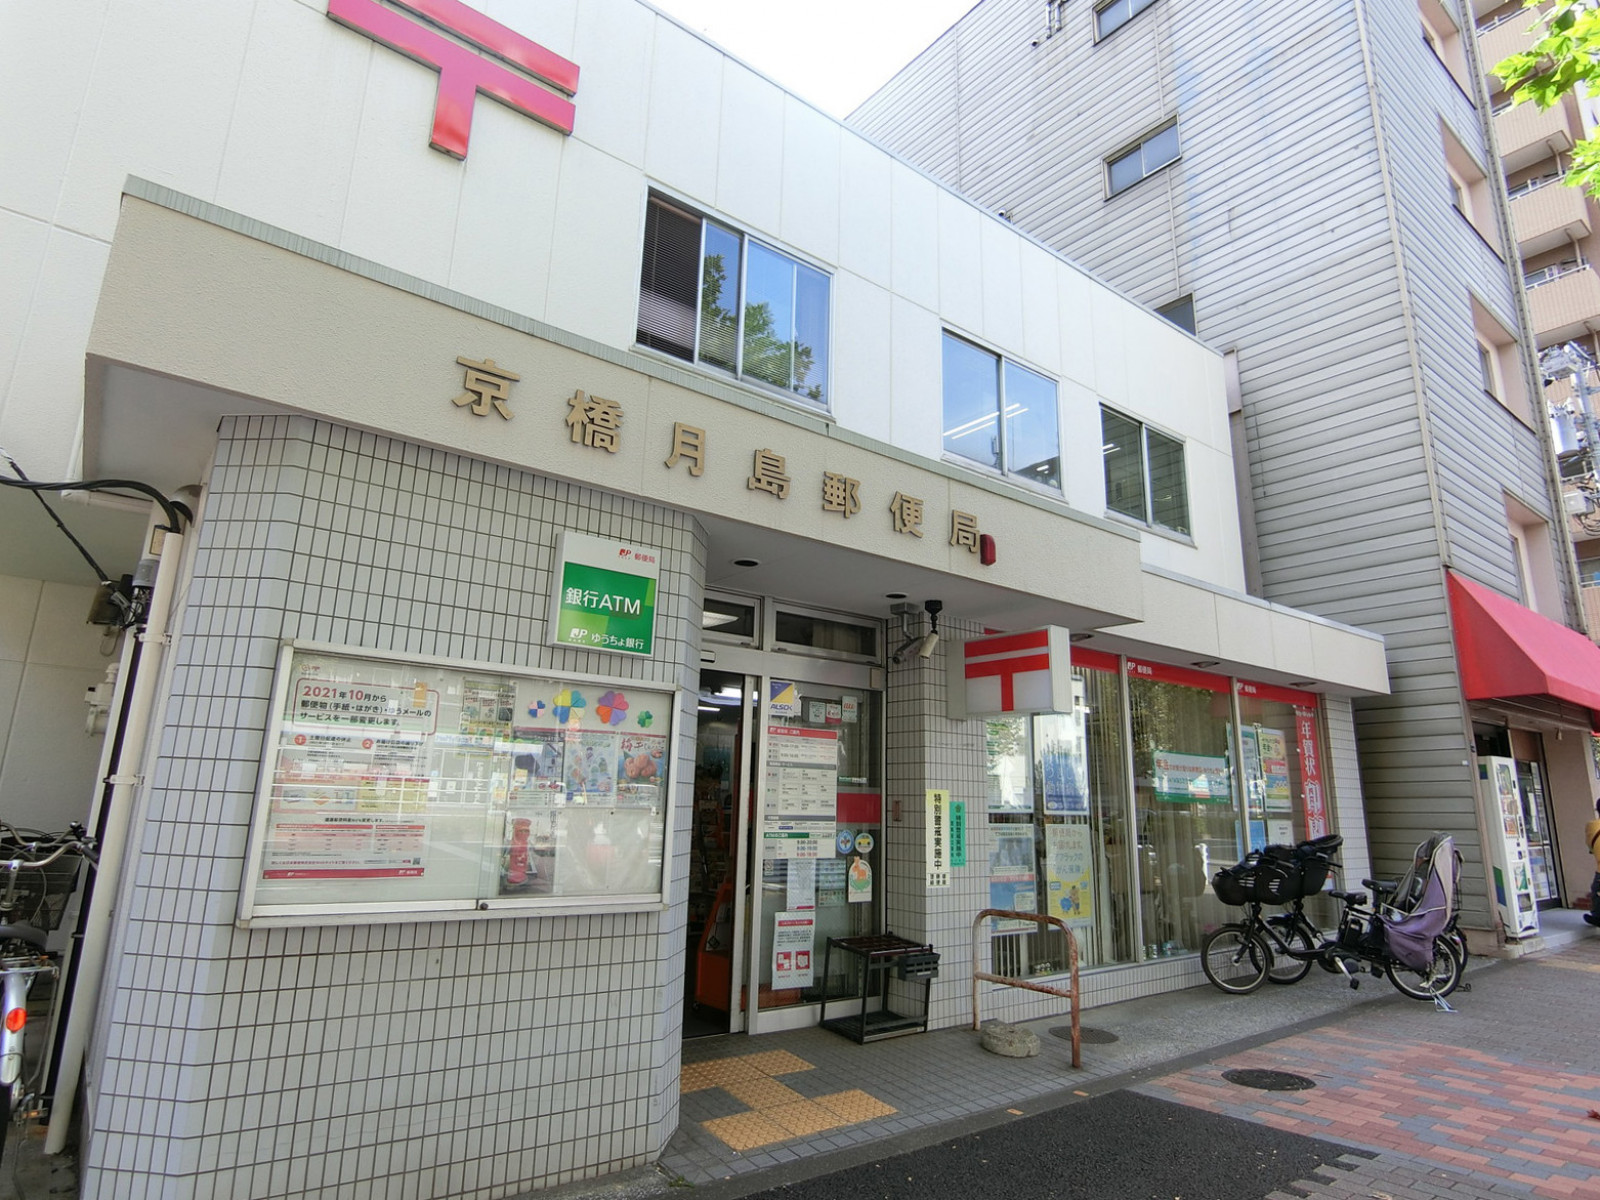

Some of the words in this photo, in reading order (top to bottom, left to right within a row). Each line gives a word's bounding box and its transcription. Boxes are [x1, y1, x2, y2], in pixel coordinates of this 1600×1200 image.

[452, 356, 981, 554] 京橋月島郵便局
[634, 553, 656, 564] 郵便局
[565, 587, 641, 615] 銀行ATM
[591, 633, 645, 650] ゆうちょ銀行
[302, 685, 388, 703] 2021年10月から
[1301, 720, 1316, 777] 年賀状
